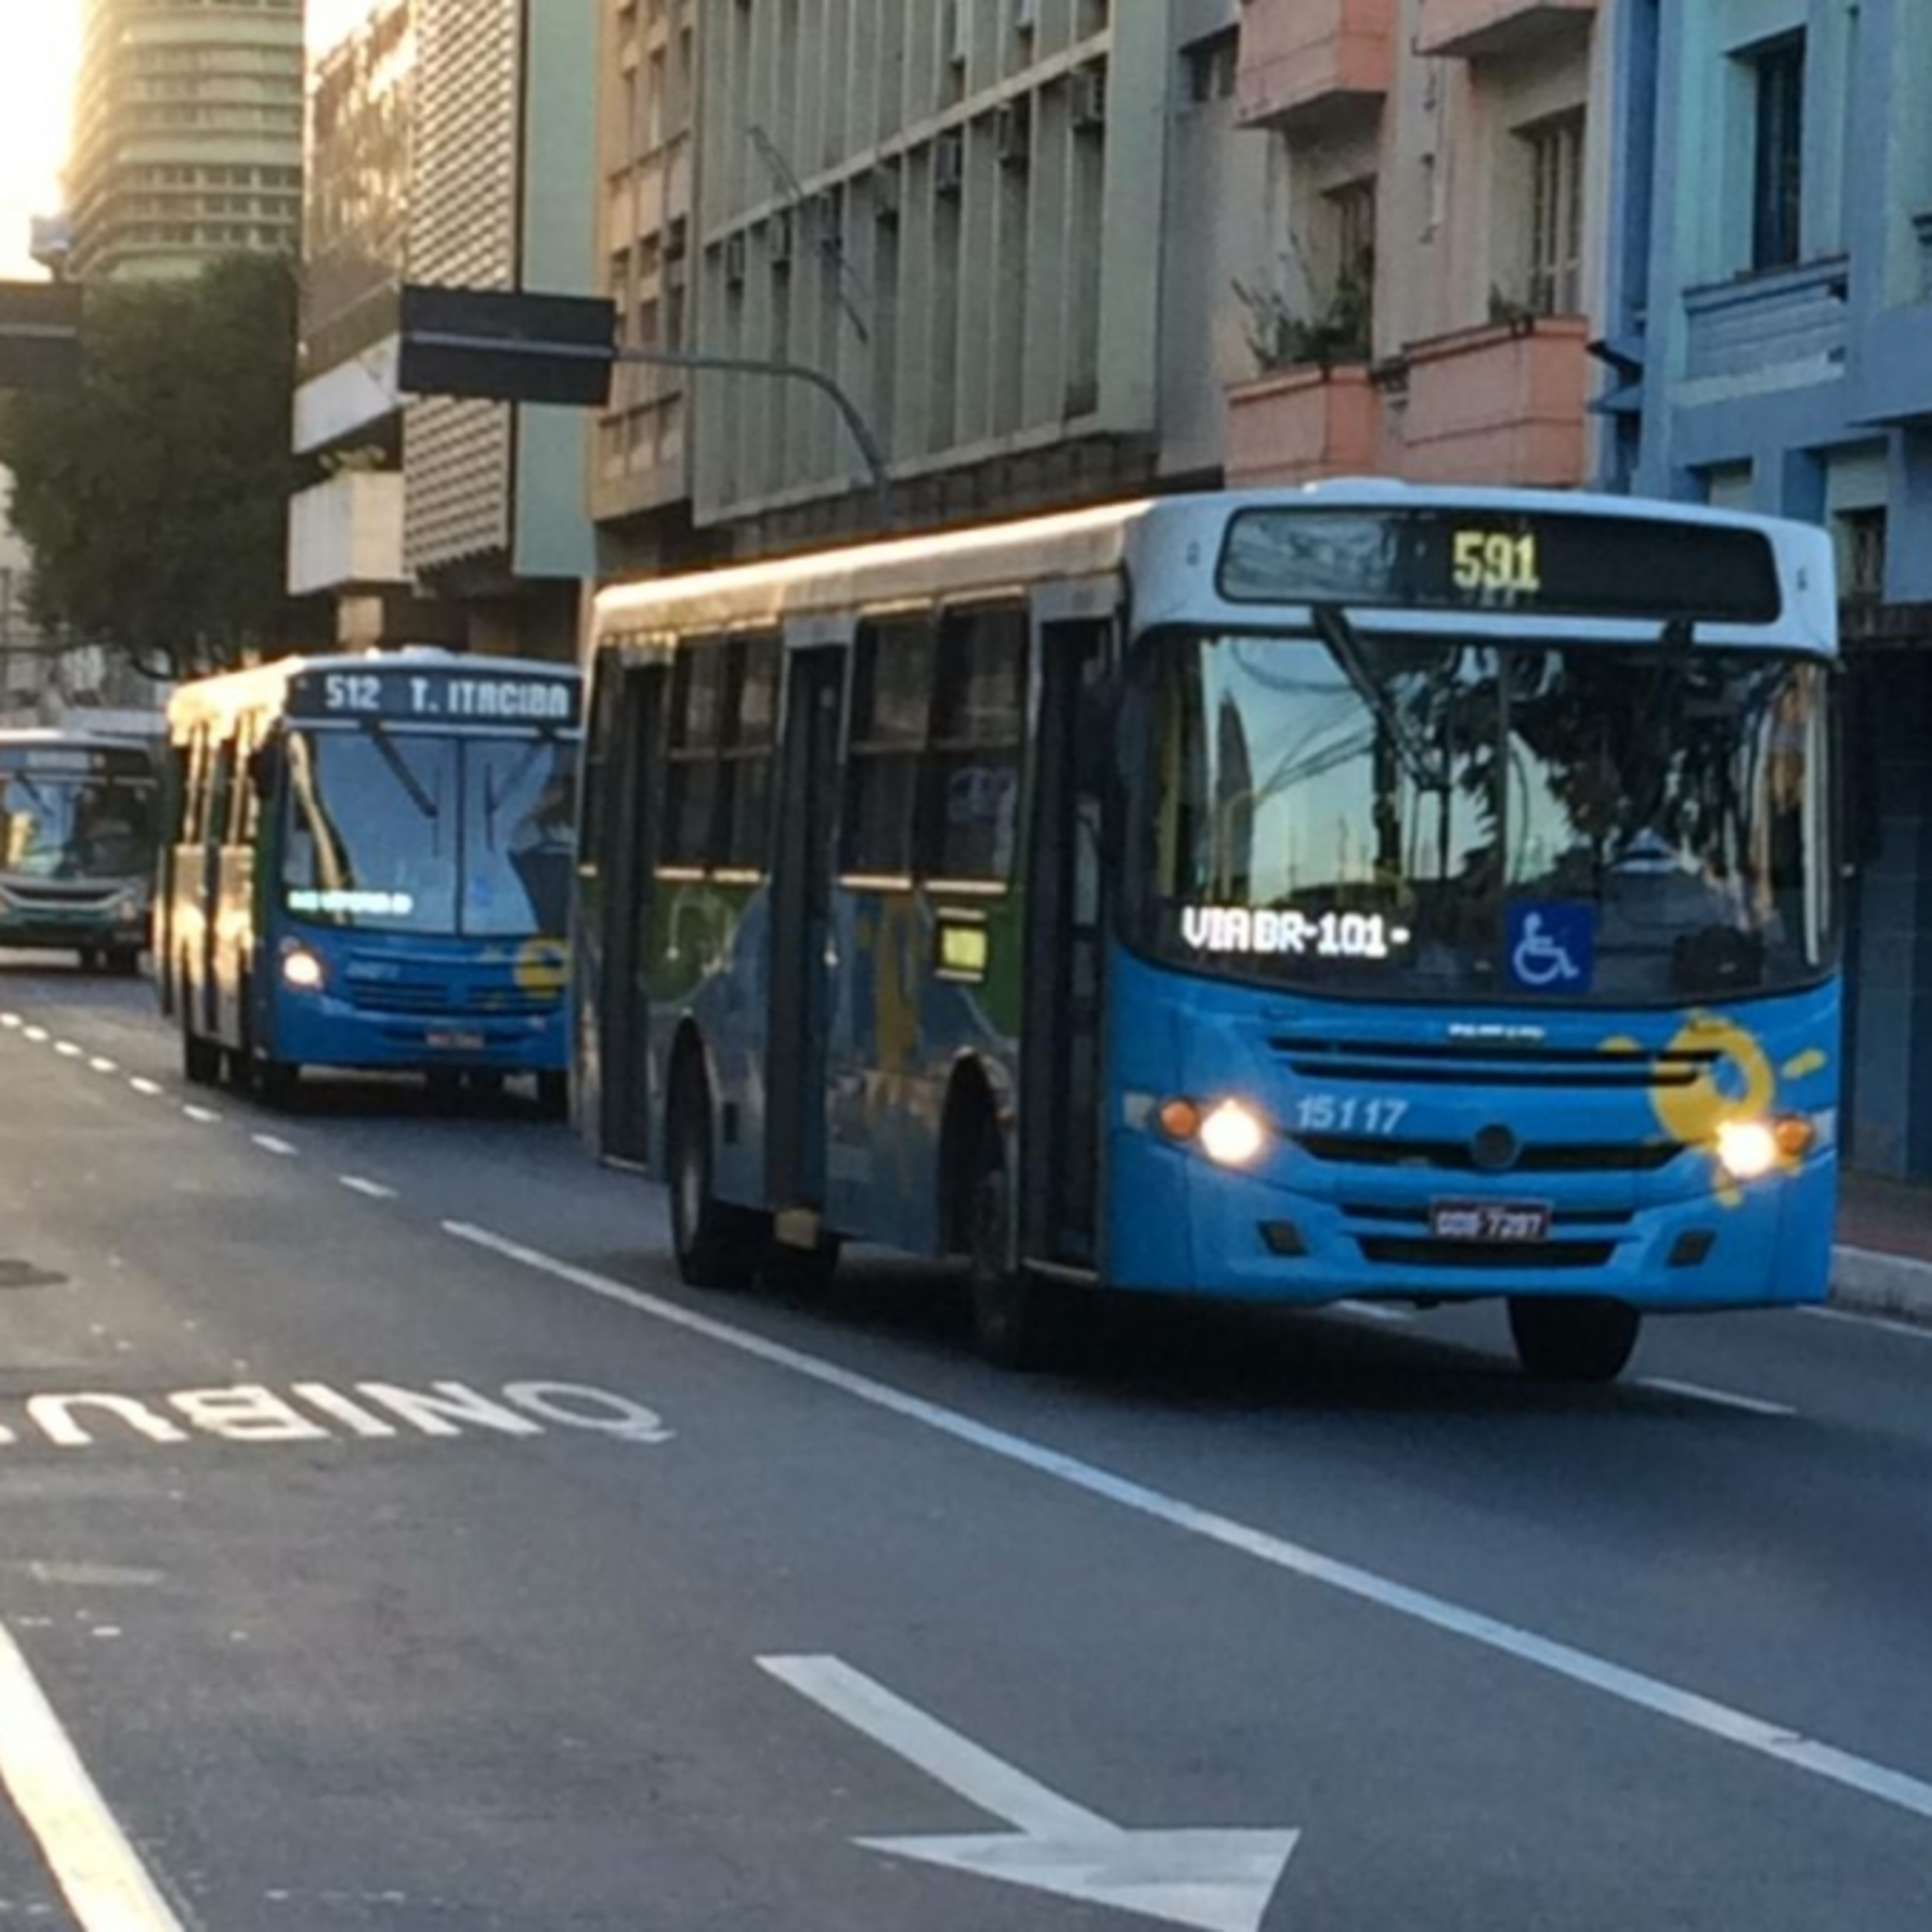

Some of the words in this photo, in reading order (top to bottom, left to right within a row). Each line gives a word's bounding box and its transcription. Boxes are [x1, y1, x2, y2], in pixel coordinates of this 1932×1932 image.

[1453, 531, 1540, 591] 591
[325, 674, 381, 710] 512
[410, 677, 440, 713] T.
[1182, 906, 1251, 952] VIA
[1296, 1094, 1409, 1134] 15117
[0, 1380, 677, 1445] ÔNIBU
